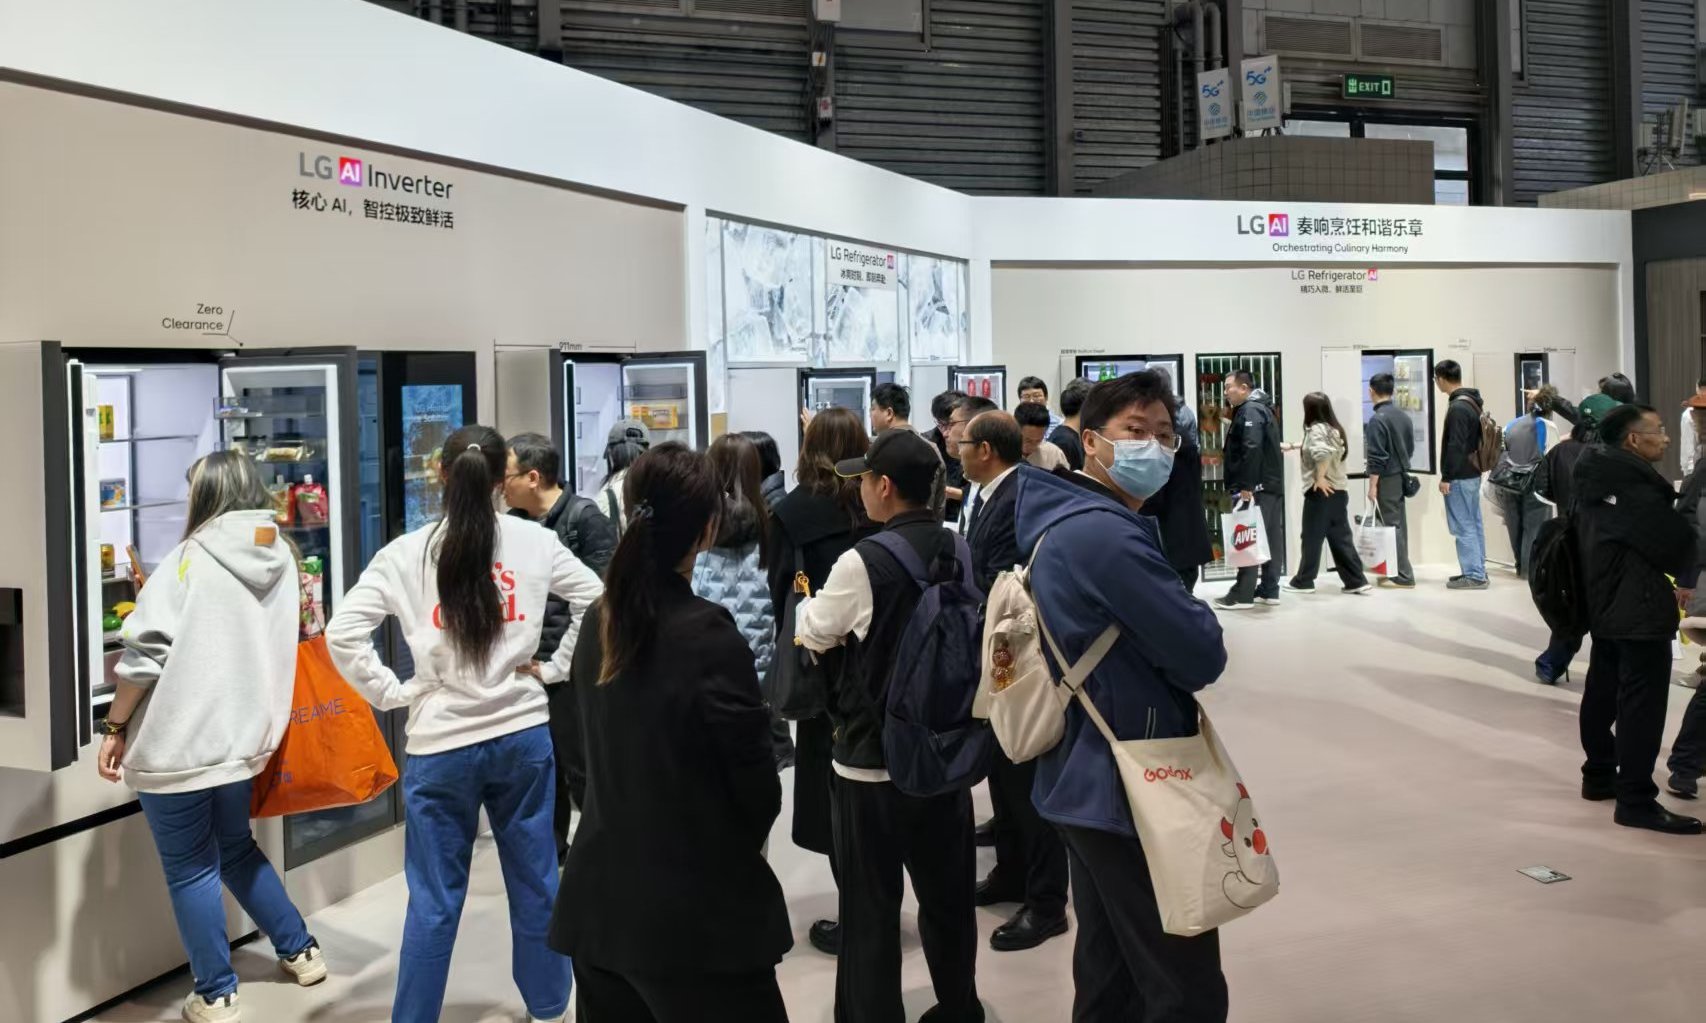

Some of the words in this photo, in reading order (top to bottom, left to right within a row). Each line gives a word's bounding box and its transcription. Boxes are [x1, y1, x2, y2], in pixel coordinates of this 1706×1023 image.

[1359, 82, 1380, 92] EXIT
[299, 152, 333, 180] LG
[340, 158, 362, 185] AI
[368, 164, 453, 199] Inverter
[292, 188, 328, 212] 核心
[1237, 214, 1265, 235] LG
[1269, 214, 1288, 236] AI
[1297, 216, 1423, 237] 奏响烹饪和谐乐章
[830, 246, 841, 260] LG
[843, 248, 886, 267] Refrigerator
[1272, 243, 1332, 254] Orchestrating
[1334, 243, 1370, 254] Culinary
[1371, 244, 1408, 254] Harmony
[1291, 271, 1305, 280] LG
[1308, 271, 1366, 282] Refrigerator
[1368, 270, 1377, 280] AI
[197, 303, 223, 315] Zero
[162, 318, 223, 330] Clearance
[1235, 529, 1257, 546] AWE
[290, 698, 346, 725] REAME
